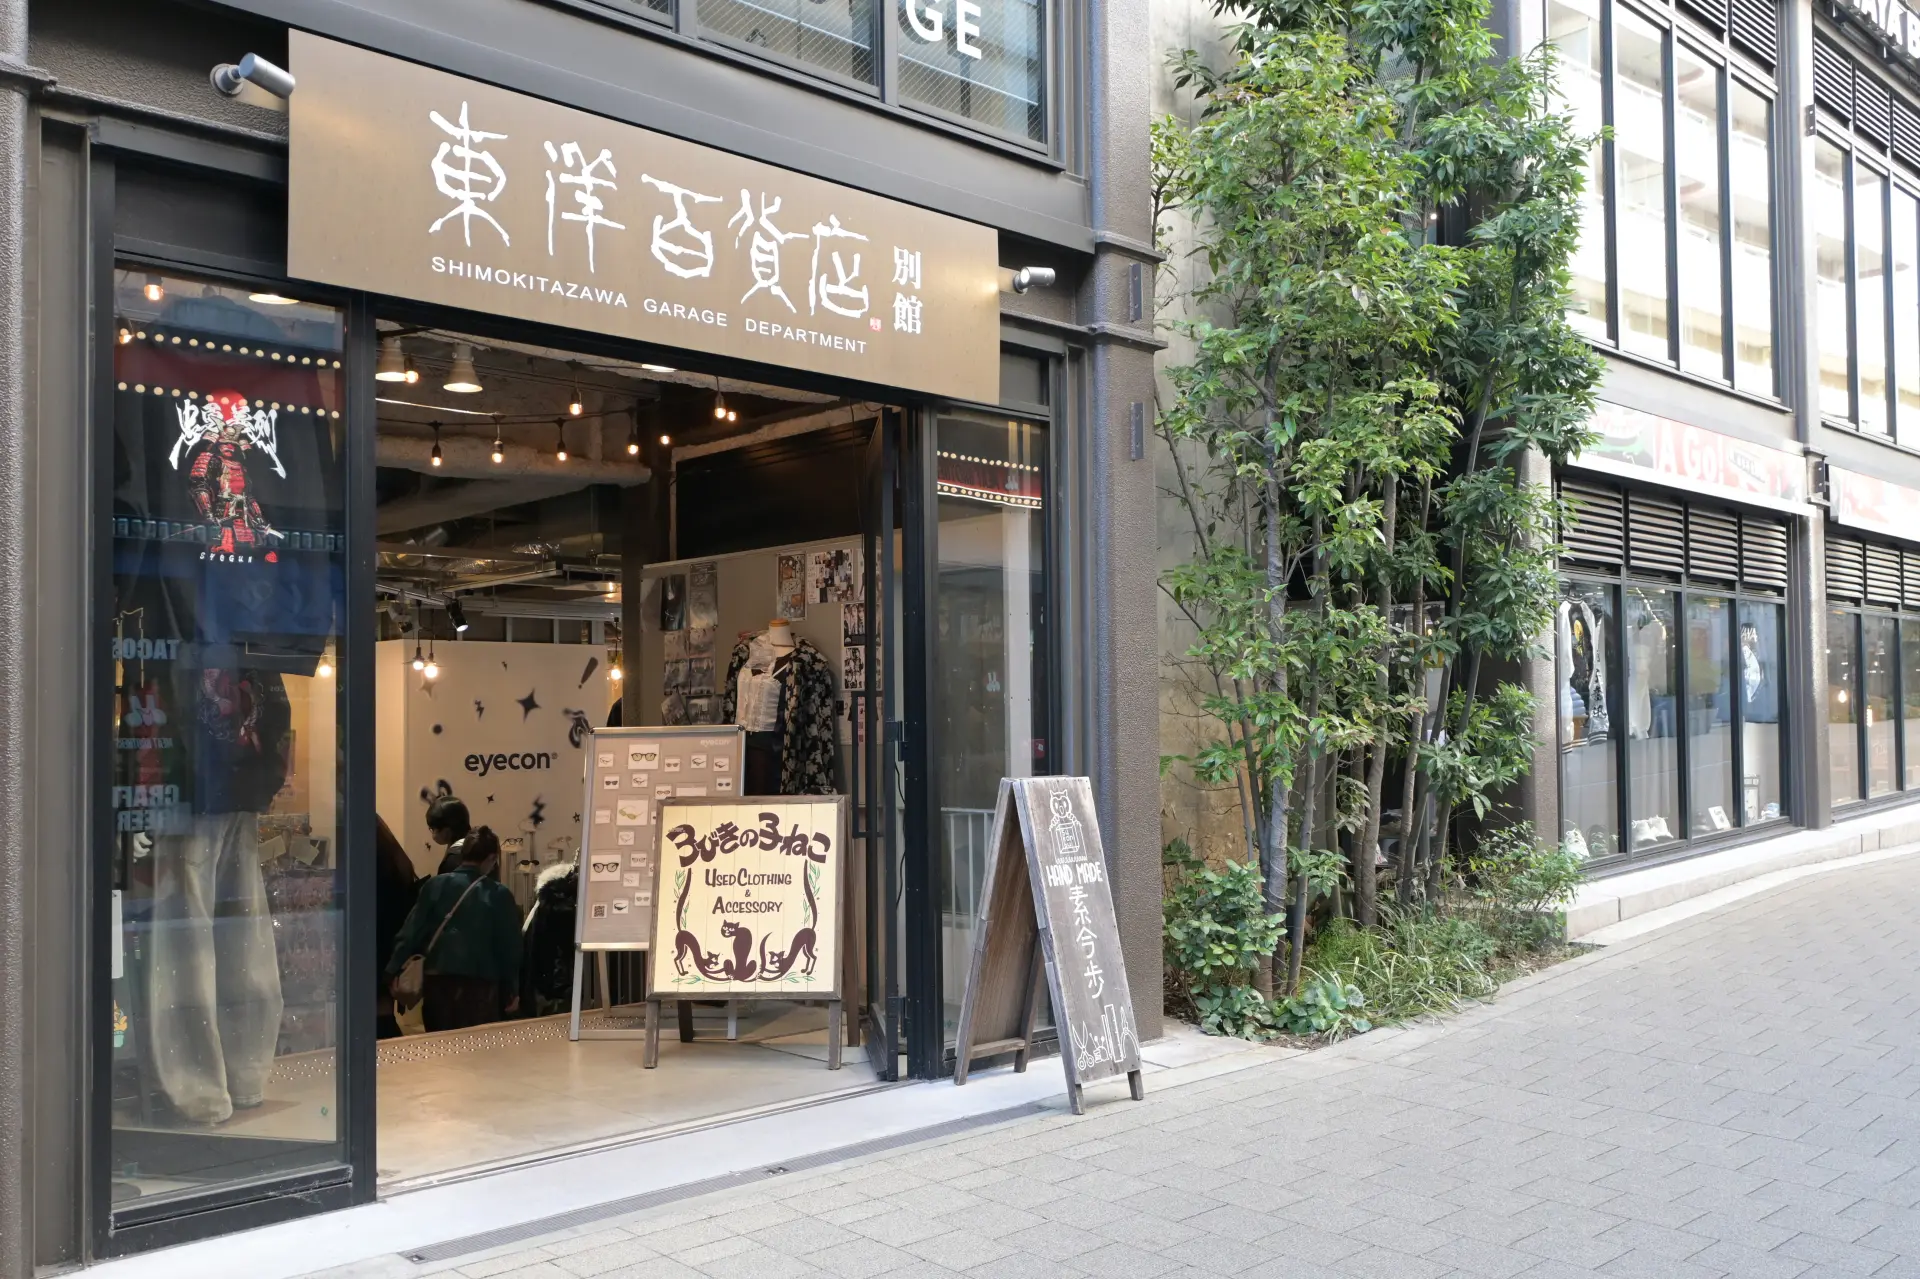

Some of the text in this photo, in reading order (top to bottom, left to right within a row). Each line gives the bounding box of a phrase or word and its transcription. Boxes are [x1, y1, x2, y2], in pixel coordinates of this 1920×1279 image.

[429, 101, 869, 318] 東洋百貨店
[431, 256, 628, 308] SHIMOKITAZAWA
[643, 298, 728, 327] GARAGE
[745, 318, 867, 354] DEPARTMENT
[892, 245, 923, 335] 別館
[744, 889, 751, 898] &
[1046, 862, 1103, 887] HAND MADE
[1069, 885, 1104, 999] 素今歩
